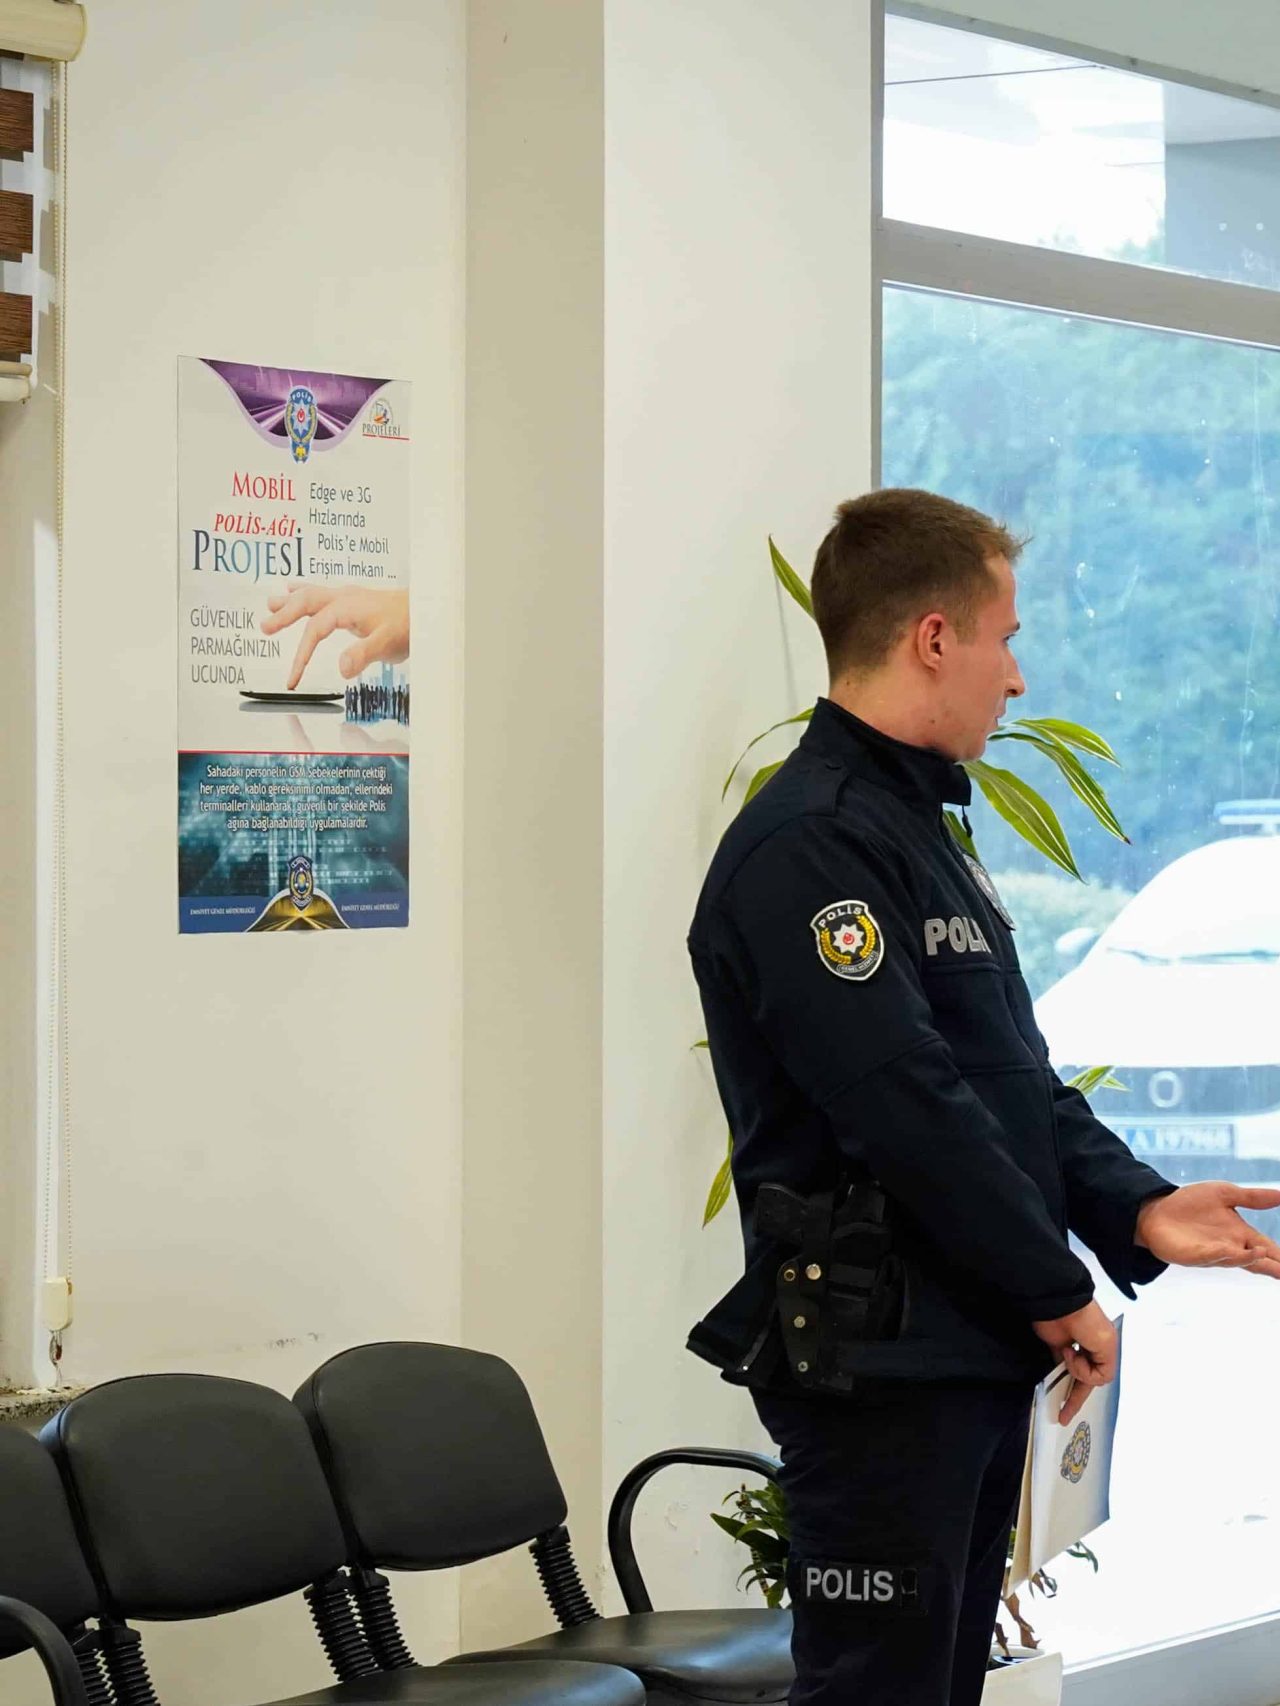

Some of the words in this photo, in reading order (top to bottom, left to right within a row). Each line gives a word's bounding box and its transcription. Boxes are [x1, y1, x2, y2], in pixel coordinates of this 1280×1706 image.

[232, 471, 296, 501] MOBİL
[310, 482, 336, 504] Edge
[340, 489, 353, 502] ve
[357, 486, 372, 504] 3G
[214, 511, 296, 537] POLİS-AĞI
[309, 507, 366, 528] Hızlarında
[192, 527, 305, 584] PROJESİ
[359, 536, 390, 555] Mobil
[309, 557, 344, 579] Erişim
[190, 604, 254, 629] GÜVENLİK
[191, 632, 281, 658] PARMAĞINIZIN
[191, 664, 246, 684] UCUNDA
[207, 764, 244, 778] Sahadaki
[245, 766, 287, 780] personelin
[200, 782, 214, 794] her
[244, 783, 266, 795] kablo
[354, 784, 393, 795] ellerindeki
[200, 799, 248, 812] terminalleri
[327, 800, 338, 811] bir
[369, 799, 386, 811] Polis
